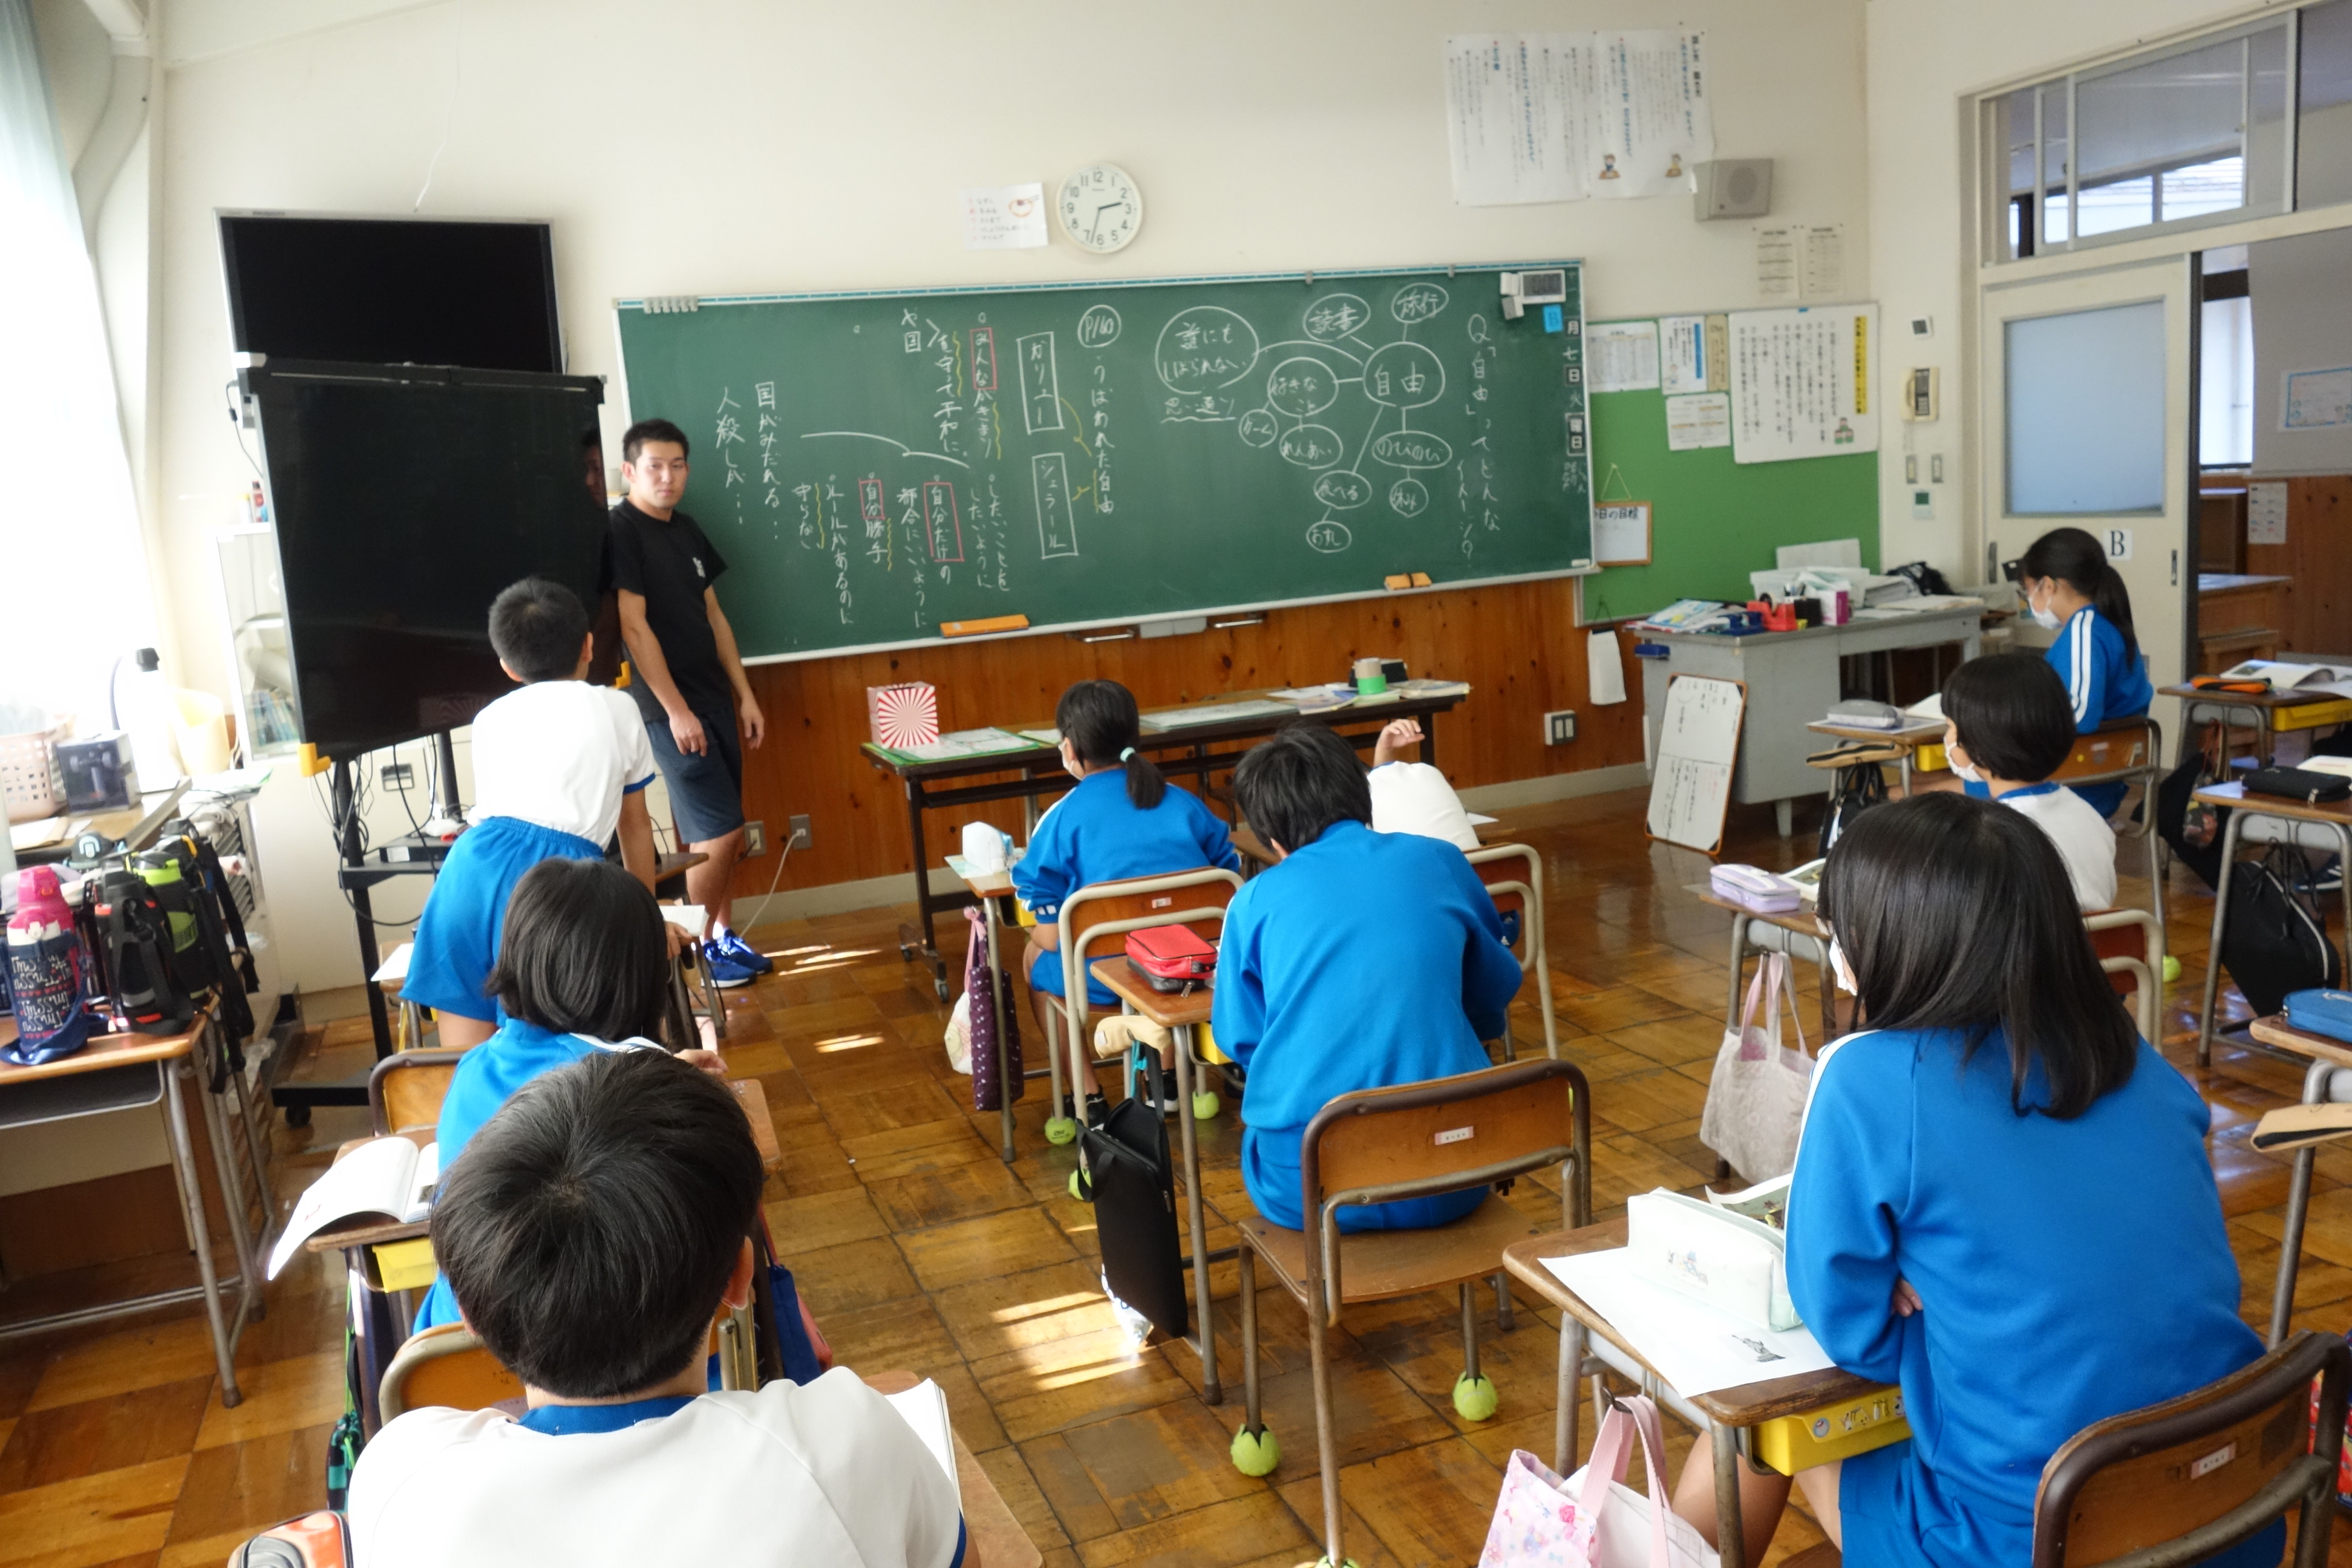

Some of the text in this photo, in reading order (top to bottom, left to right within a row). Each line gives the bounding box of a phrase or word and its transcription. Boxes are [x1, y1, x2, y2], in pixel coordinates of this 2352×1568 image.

[1080, 175, 1088, 186] 11
[1093, 171, 1103, 182] 12
[1111, 175, 1115, 186] 1
[1070, 186, 1079, 197] 10
[1120, 188, 1127, 198] 2
[1067, 203, 1074, 213] 9
[1125, 203, 1131, 214] 3
[1071, 218, 1079, 229] 8
[1121, 220, 1128, 230] 4
[1083, 229, 1090, 241] 7
[1097, 234, 1104, 245] 6
[1111, 230, 1118, 241] 5
[1397, 288, 1439, 318] 旅行
[1308, 302, 1359, 333] 読書
[1374, 361, 1425, 396] 自由
[1091, 355, 1116, 514] うばわれた自由
[866, 485, 887, 564] 自分勝手
[2111, 530, 2125, 557] B
